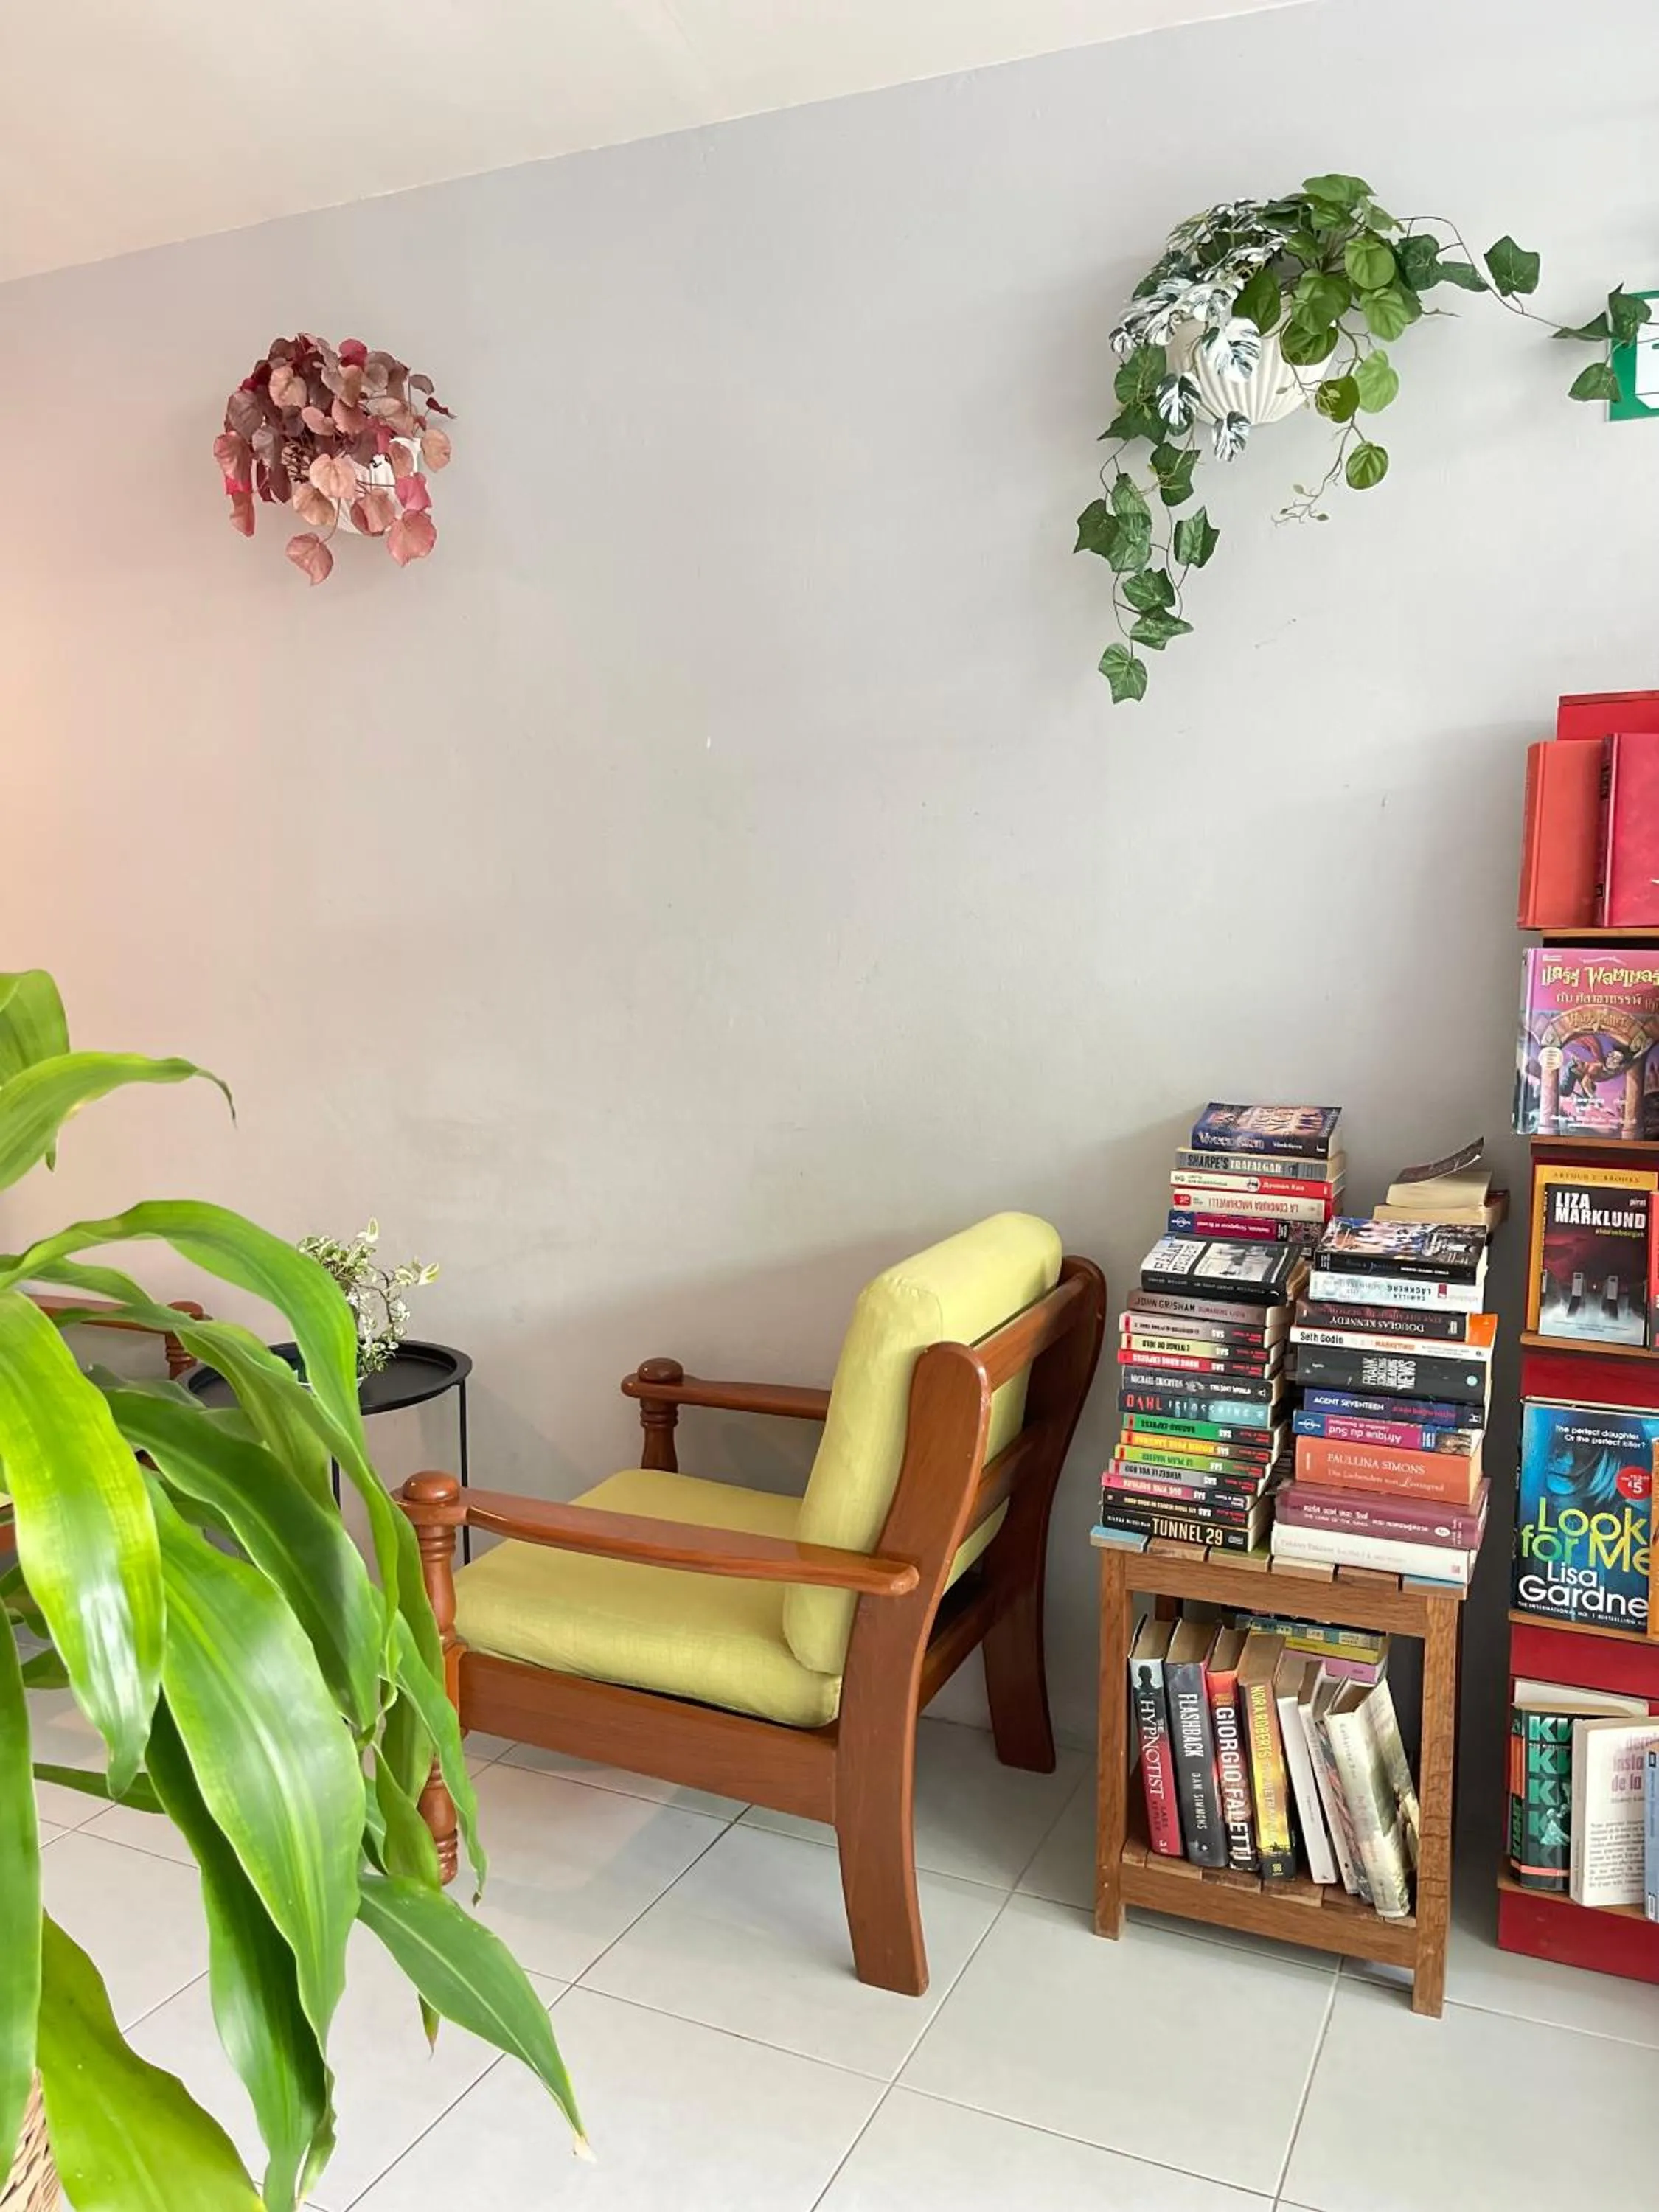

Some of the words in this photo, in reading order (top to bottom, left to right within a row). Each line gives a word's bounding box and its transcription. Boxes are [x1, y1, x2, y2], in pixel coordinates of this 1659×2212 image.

[1187, 1154, 1230, 1169] SHARPE'S
[1556, 1192, 1590, 1209] LIZA
[1555, 1208, 1646, 1229] MARKLUND
[1135, 1297, 1157, 1308] JOHN
[1158, 1300, 1195, 1312] GRISHAM
[1330, 1315, 1377, 1330] KENNEDY
[1380, 1321, 1425, 1333] DOUGLAS
[1300, 1332, 1318, 1343] Seth
[1321, 1333, 1344, 1344] Godin
[1126, 1394, 1162, 1411] DAHL
[1313, 1397, 1338, 1406] AGENT
[1340, 1399, 1384, 1411] SEVENTEEN
[1329, 1427, 1347, 1437] Sud
[1349, 1428, 1361, 1439] du
[1366, 1430, 1402, 1444] Afrique
[1556, 1425, 1569, 1433] The
[1571, 1427, 1600, 1437] perfect
[1576, 1435, 1589, 1443] the
[1592, 1437, 1621, 1447] perfect
[1623, 1440, 1646, 1449] killer?
[1327, 1453, 1379, 1470] PAULLINA
[1382, 1462, 1425, 1475] SIMONS
[1538, 1497, 1647, 1545] Look
[1152, 1518, 1203, 1543] TUNNEL
[1206, 1528, 1223, 1546] 29
[1522, 1524, 1579, 1565] for
[1589, 1531, 1650, 1575] Me
[1548, 1560, 1597, 1587] Lisa
[1518, 1574, 1649, 1618] Gardne
[1251, 1686, 1267, 1713] NORA
[1178, 1694, 1204, 1757] FLASHBACK
[1216, 1707, 1242, 1782] GIORGIO
[1254, 1714, 1272, 1759] ROBERTS
[1140, 1700, 1164, 1799] HYPNOTIST
[1192, 1772, 1203, 1790] DAN
[1612, 1775, 1626, 1791] de
[1630, 1774, 1642, 1790] la
[1194, 1794, 1207, 1829] SIMMONS
[1225, 1788, 1251, 1860] FALETTI
